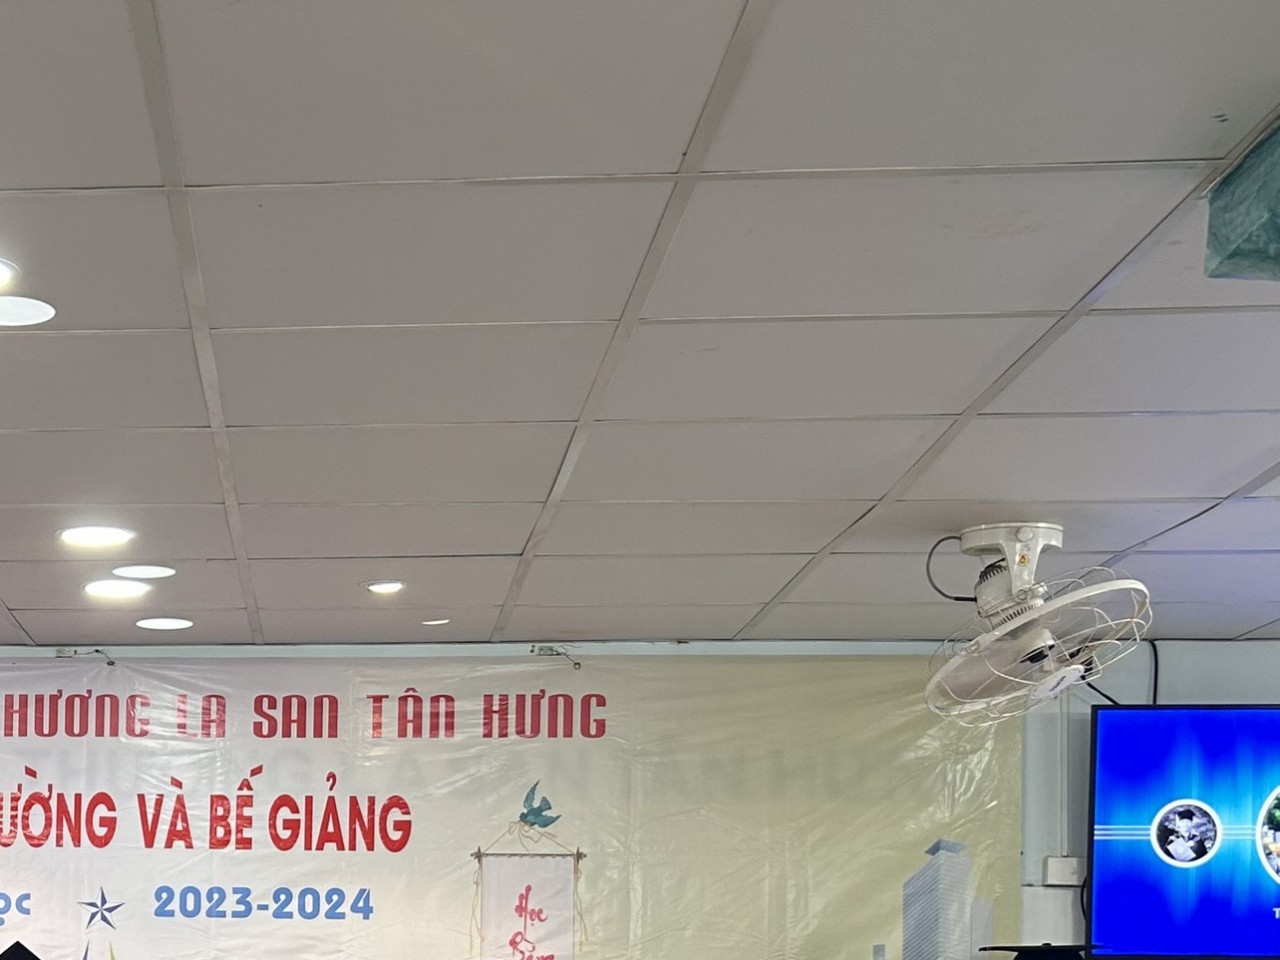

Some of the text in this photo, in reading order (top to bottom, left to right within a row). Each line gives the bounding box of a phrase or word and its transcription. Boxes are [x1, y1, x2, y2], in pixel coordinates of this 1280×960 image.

[176, 692, 226, 740] LA
[253, 693, 339, 740] SAN
[366, 687, 456, 739] TÂN
[482, 688, 608, 740] HƯNG
[136, 776, 194, 850] VÀ
[209, 763, 264, 852] BẾ
[267, 771, 412, 853] GIẢNG
[153, 884, 375, 921] 2023-2024
